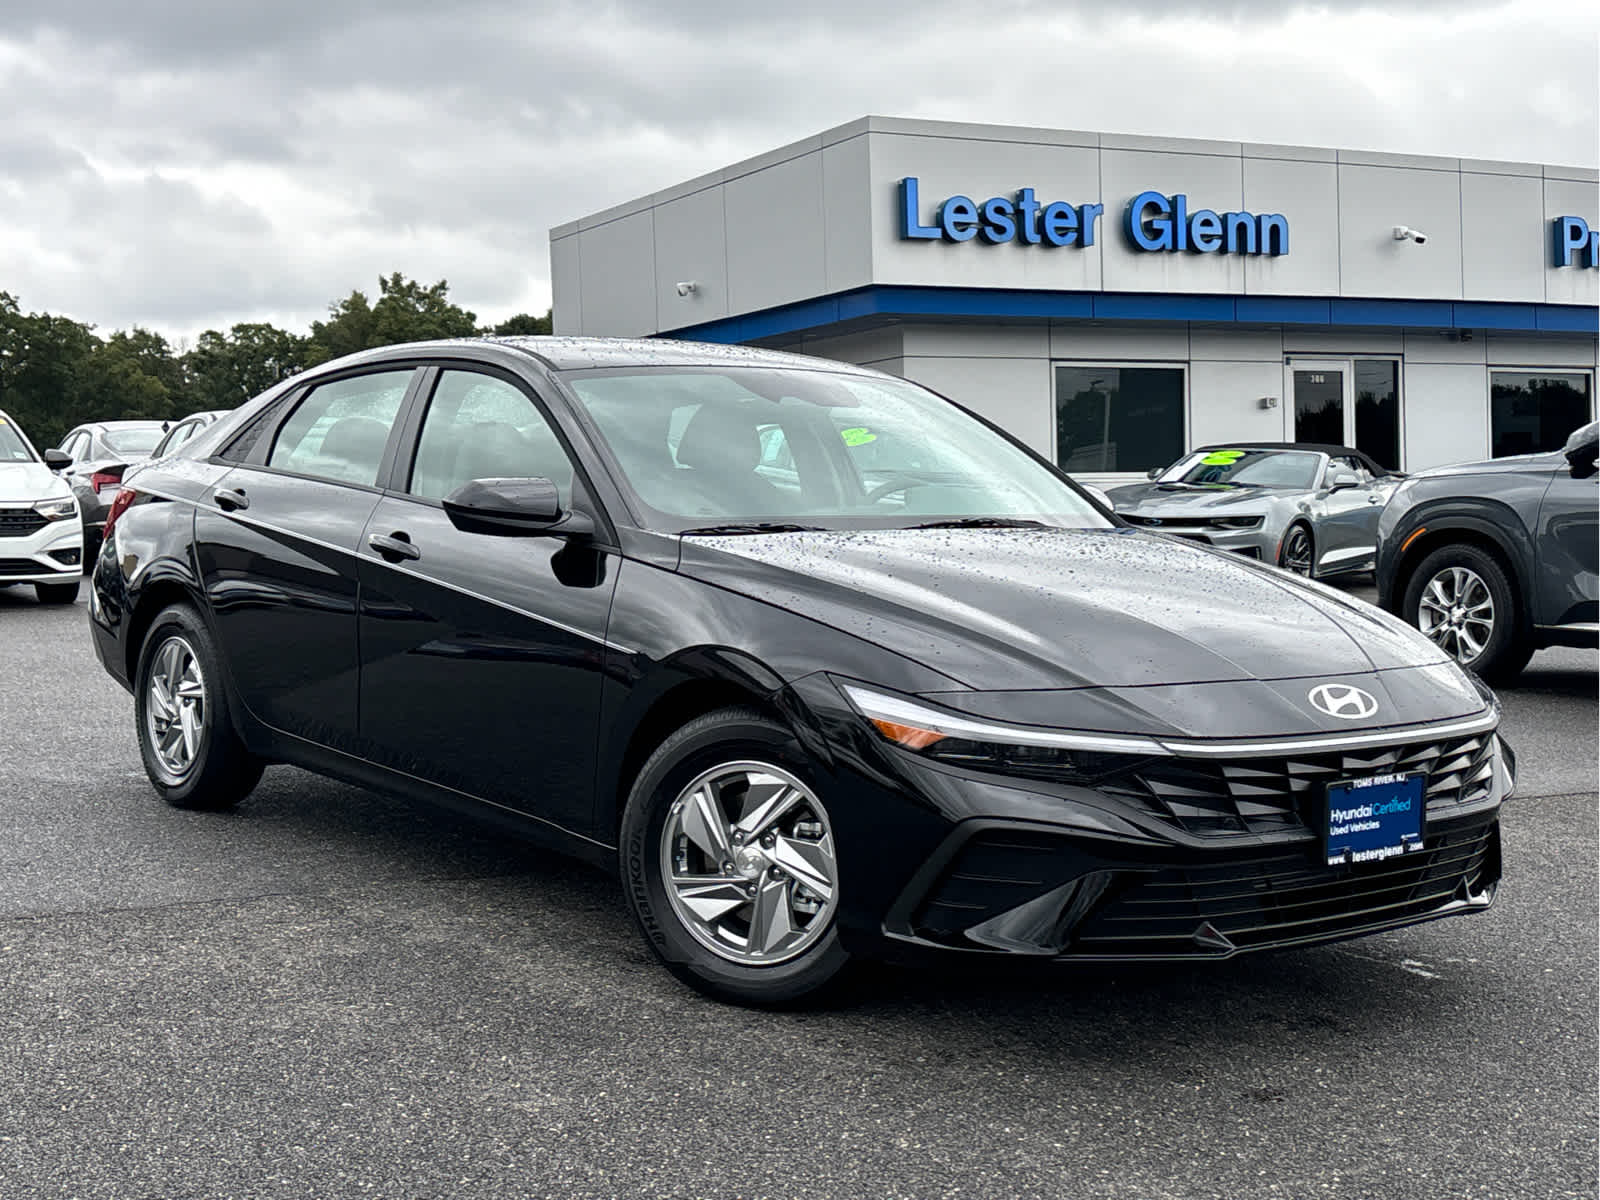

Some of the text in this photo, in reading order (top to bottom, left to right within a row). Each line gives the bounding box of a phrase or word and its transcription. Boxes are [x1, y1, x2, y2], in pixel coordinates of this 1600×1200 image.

[899, 177, 1289, 256] Lester Glenn
[1353, 777, 1372, 788] TOMS
[1330, 821, 1380, 836] Used Vehicles
[1352, 845, 1404, 862] lesterglenn
